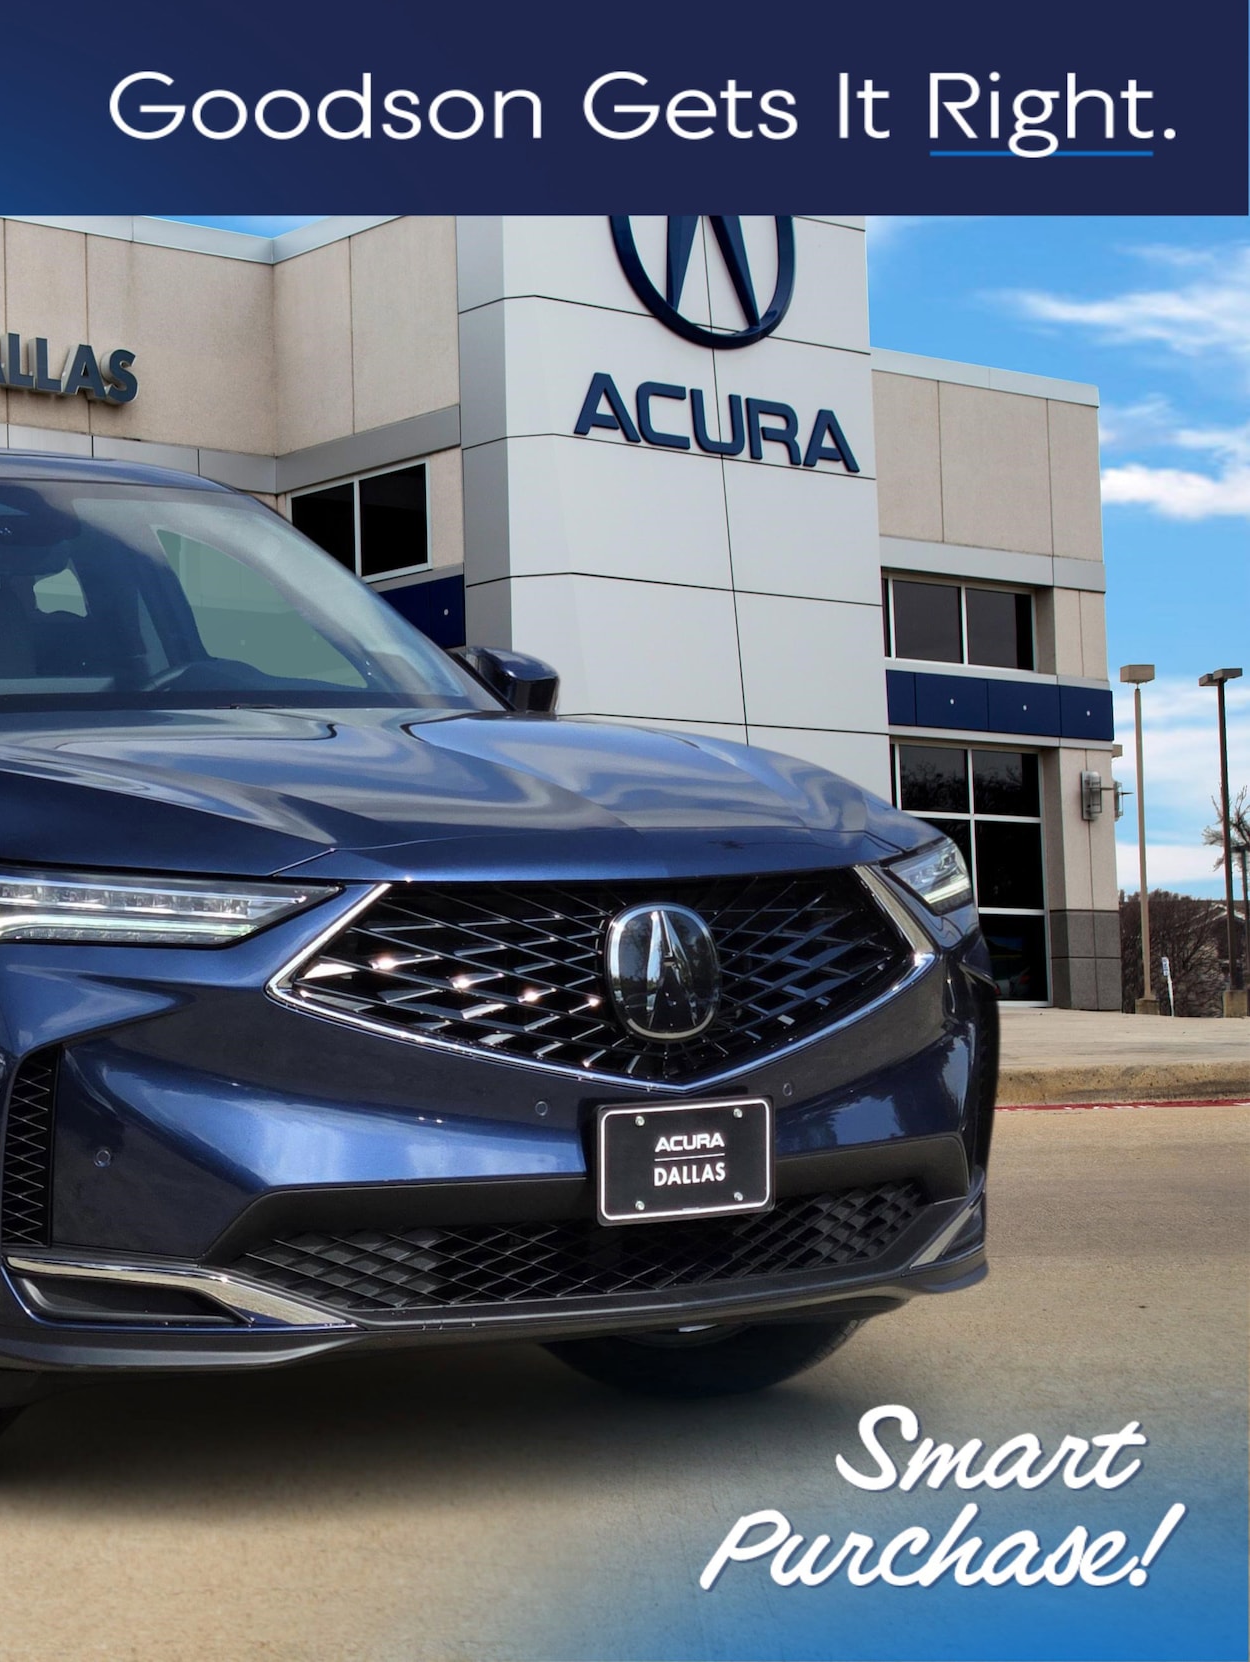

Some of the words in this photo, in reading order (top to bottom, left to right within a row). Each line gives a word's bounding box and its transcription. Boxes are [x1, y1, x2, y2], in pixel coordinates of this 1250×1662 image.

[574, 372, 860, 473] ACURA
[655, 1132, 725, 1152] ACURA
[654, 1162, 725, 1186] DALLAS
